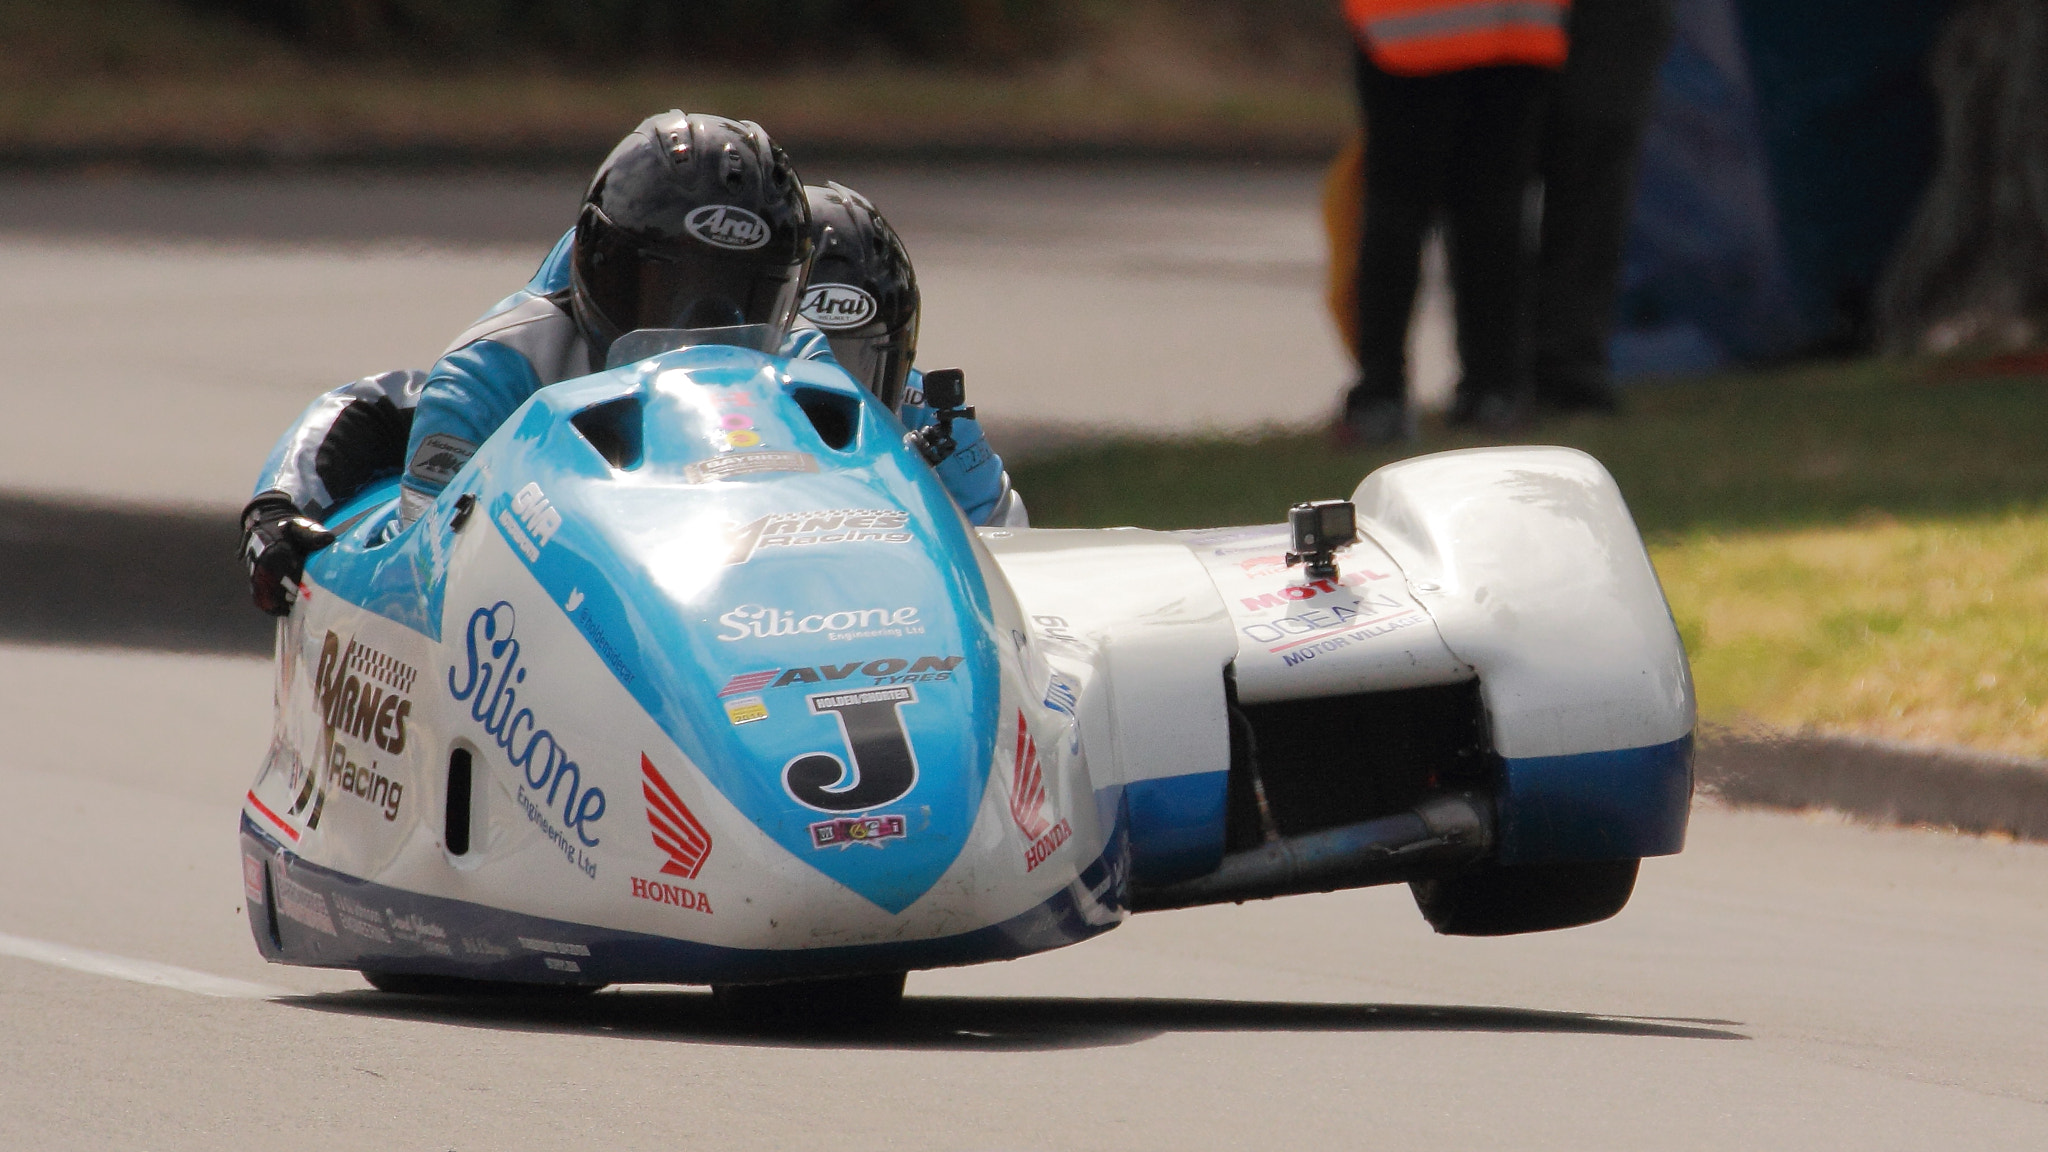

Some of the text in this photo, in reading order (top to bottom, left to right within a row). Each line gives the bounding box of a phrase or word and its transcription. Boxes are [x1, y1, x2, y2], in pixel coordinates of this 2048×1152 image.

[695, 208, 764, 242] Arai
[801, 290, 866, 315] Arai
[757, 530, 914, 548] Racing
[717, 604, 921, 641] Silicone
[827, 625, 925, 641] Engineering Ltd
[1242, 593, 1404, 643] OCEAN
[1282, 614, 1426, 668] MOTOR VILLAGE
[772, 656, 966, 688] AVON
[874, 671, 951, 686] TYRES
[449, 600, 606, 848] Silicone
[783, 685, 918, 812] J
[328, 731, 404, 823] Racing
[517, 784, 598, 880] Engineering Ltd
[1024, 818, 1073, 873] HONDA
[631, 877, 714, 914] HONDA
